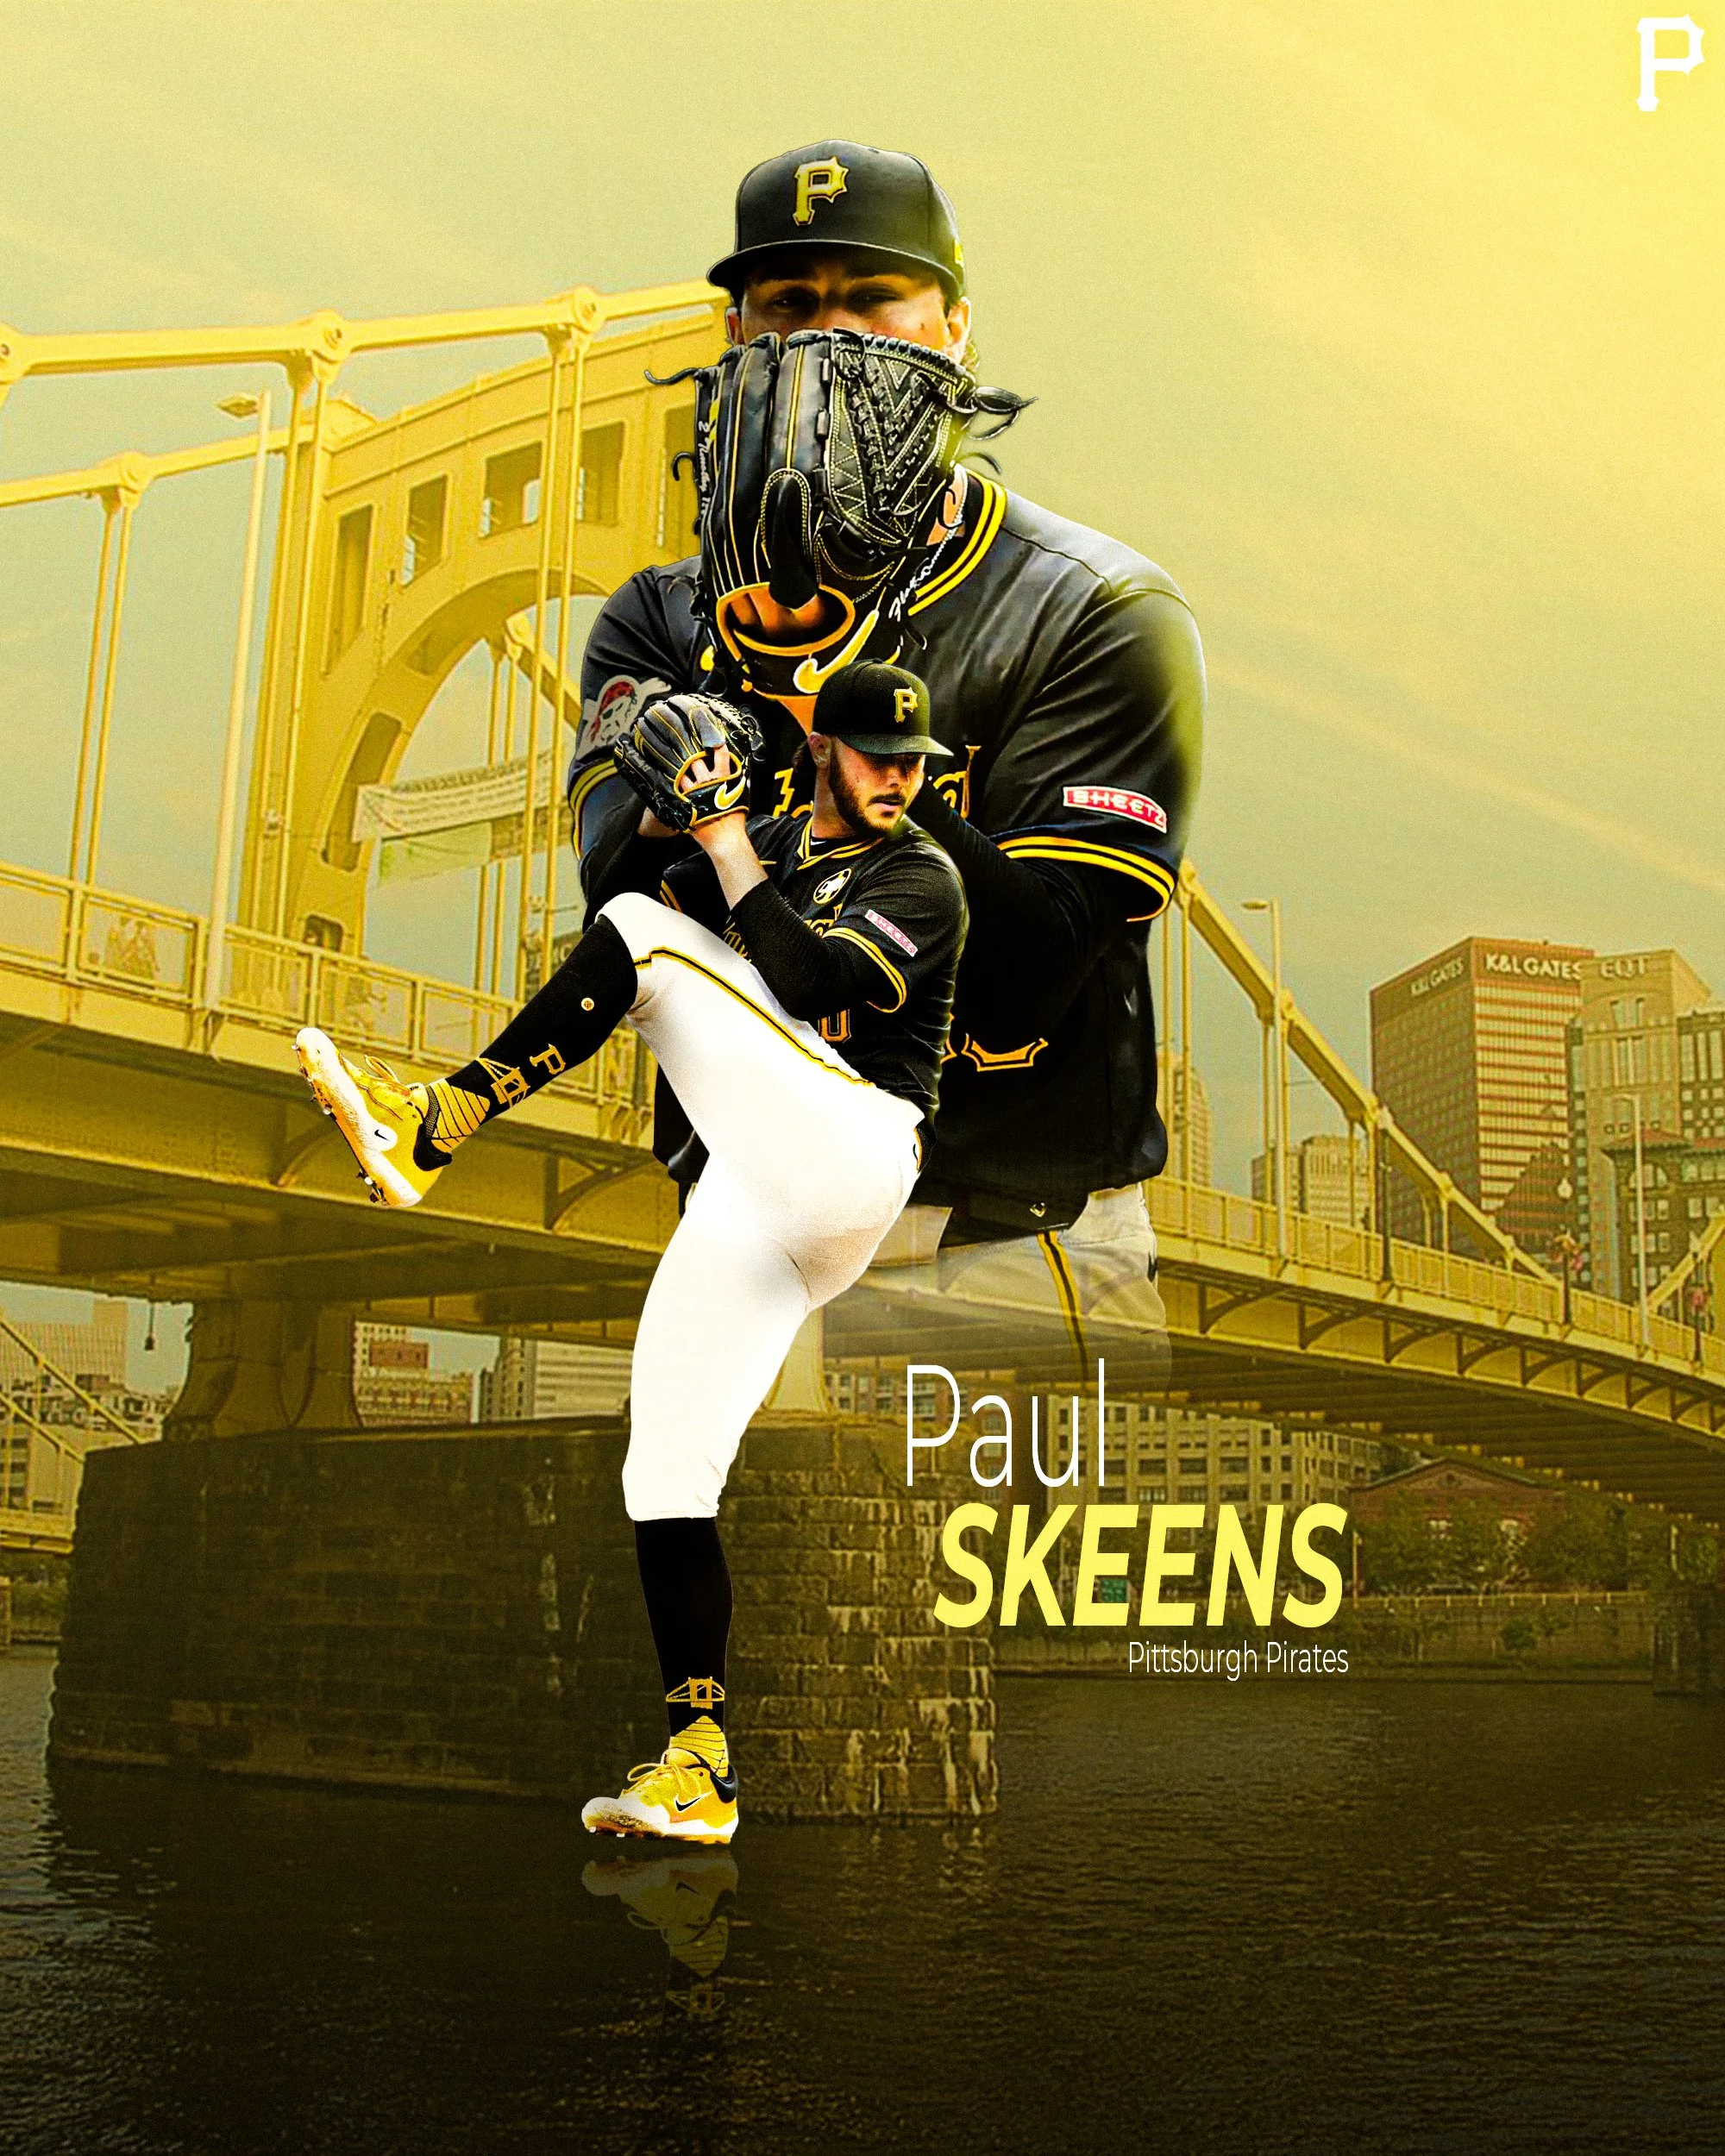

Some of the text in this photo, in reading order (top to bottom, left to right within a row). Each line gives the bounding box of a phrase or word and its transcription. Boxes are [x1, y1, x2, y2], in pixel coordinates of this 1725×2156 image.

[793, 155, 850, 226] P
[894, 686, 919, 724] P
[1522, 956, 1582, 981] GATES
[529, 1043, 567, 1075] P
